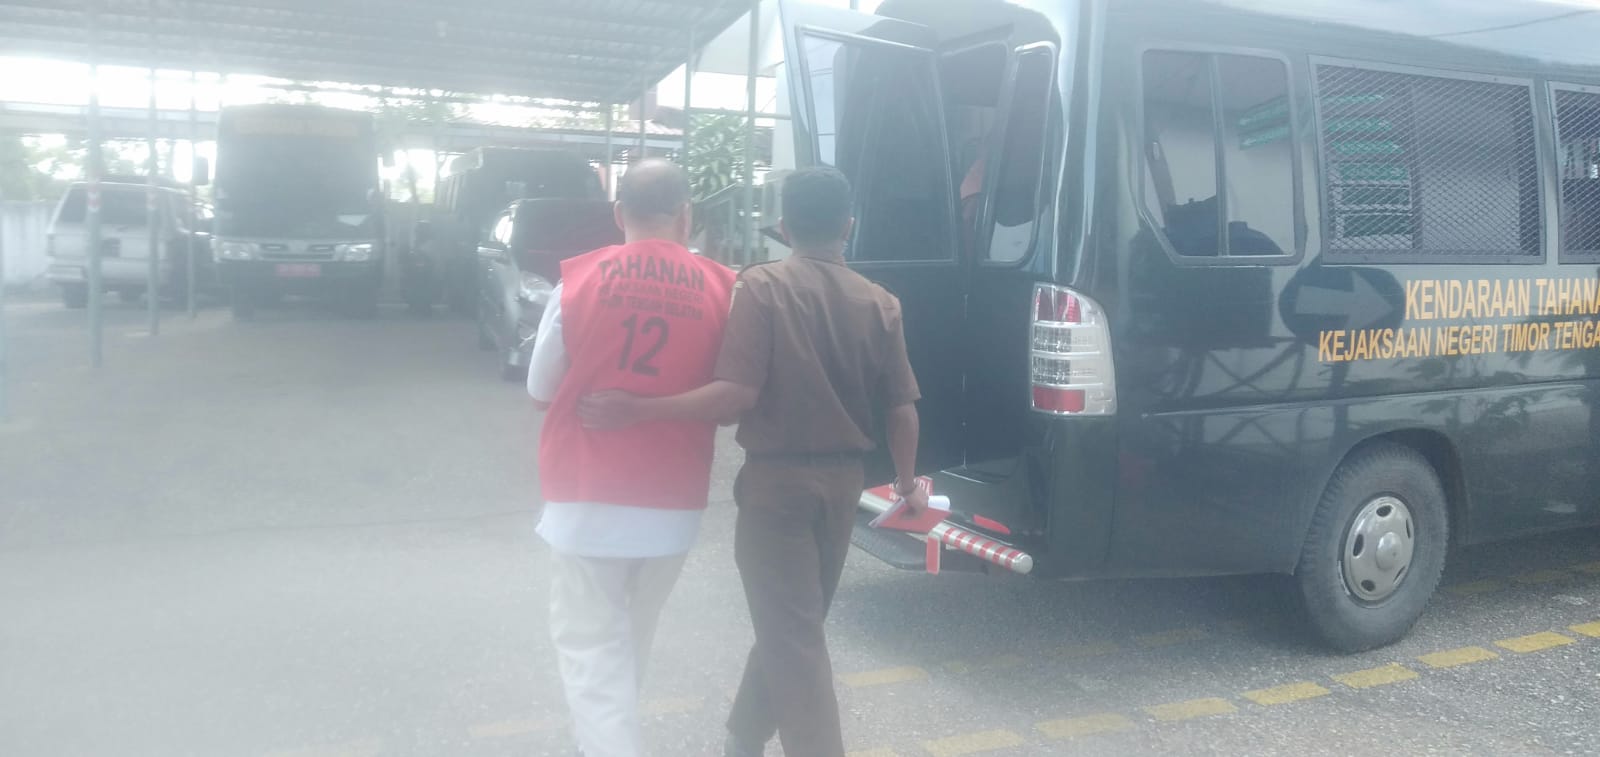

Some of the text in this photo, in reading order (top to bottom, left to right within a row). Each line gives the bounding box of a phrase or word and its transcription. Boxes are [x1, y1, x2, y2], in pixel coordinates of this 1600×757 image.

[597, 255, 705, 292] TAHANAN
[1405, 279, 1531, 320] KENDARAAN
[616, 312, 670, 376] 12
[1318, 327, 1431, 362] KEJAKSAAN
[1435, 324, 1498, 355] NEGERI
[1502, 322, 1549, 352] TIMOR
